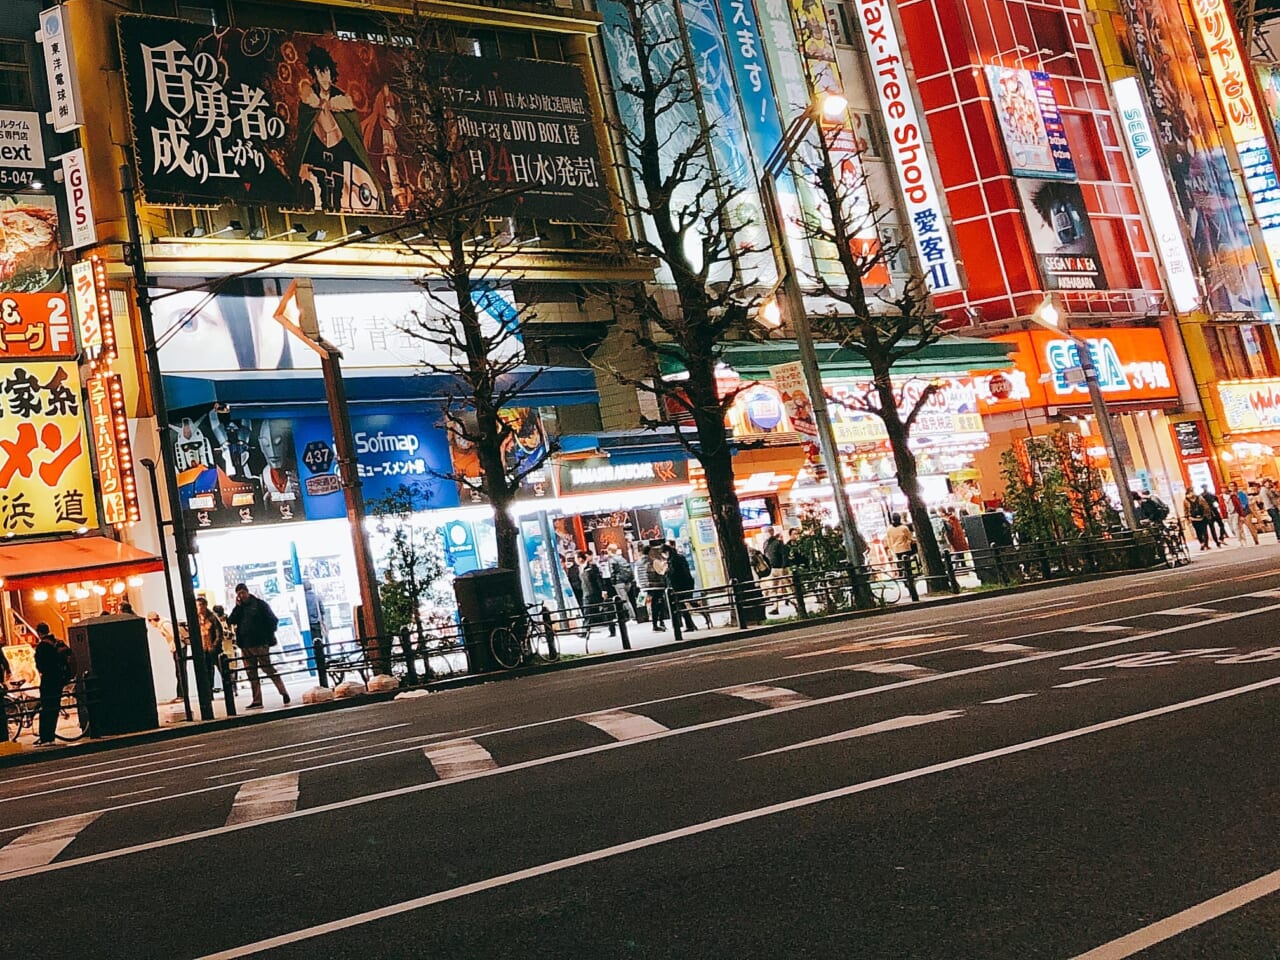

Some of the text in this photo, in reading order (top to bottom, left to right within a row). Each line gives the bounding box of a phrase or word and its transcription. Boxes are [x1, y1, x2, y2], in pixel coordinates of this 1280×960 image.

[140, 40, 286, 142] 盾の勇者の
[150, 118, 265, 185] 成り上がり
[458, 115, 580, 145] Blu-ray & DVD BOX 1巻
[1124, 107, 1152, 160] SEGA
[890, 123, 928, 205] Shop
[69, 168, 87, 226] GPS
[1045, 256, 1067, 272] SEGA
[1058, 276, 1096, 289] AKIHABARA
[47, 298, 69, 354] 2F
[76, 273, 99, 344] ラーメン
[306, 314, 421, 352] 野青空
[91, 380, 117, 493] ステーキ&ハンバーグ
[305, 448, 330, 465] 437
[354, 432, 419, 459] Sofmap
